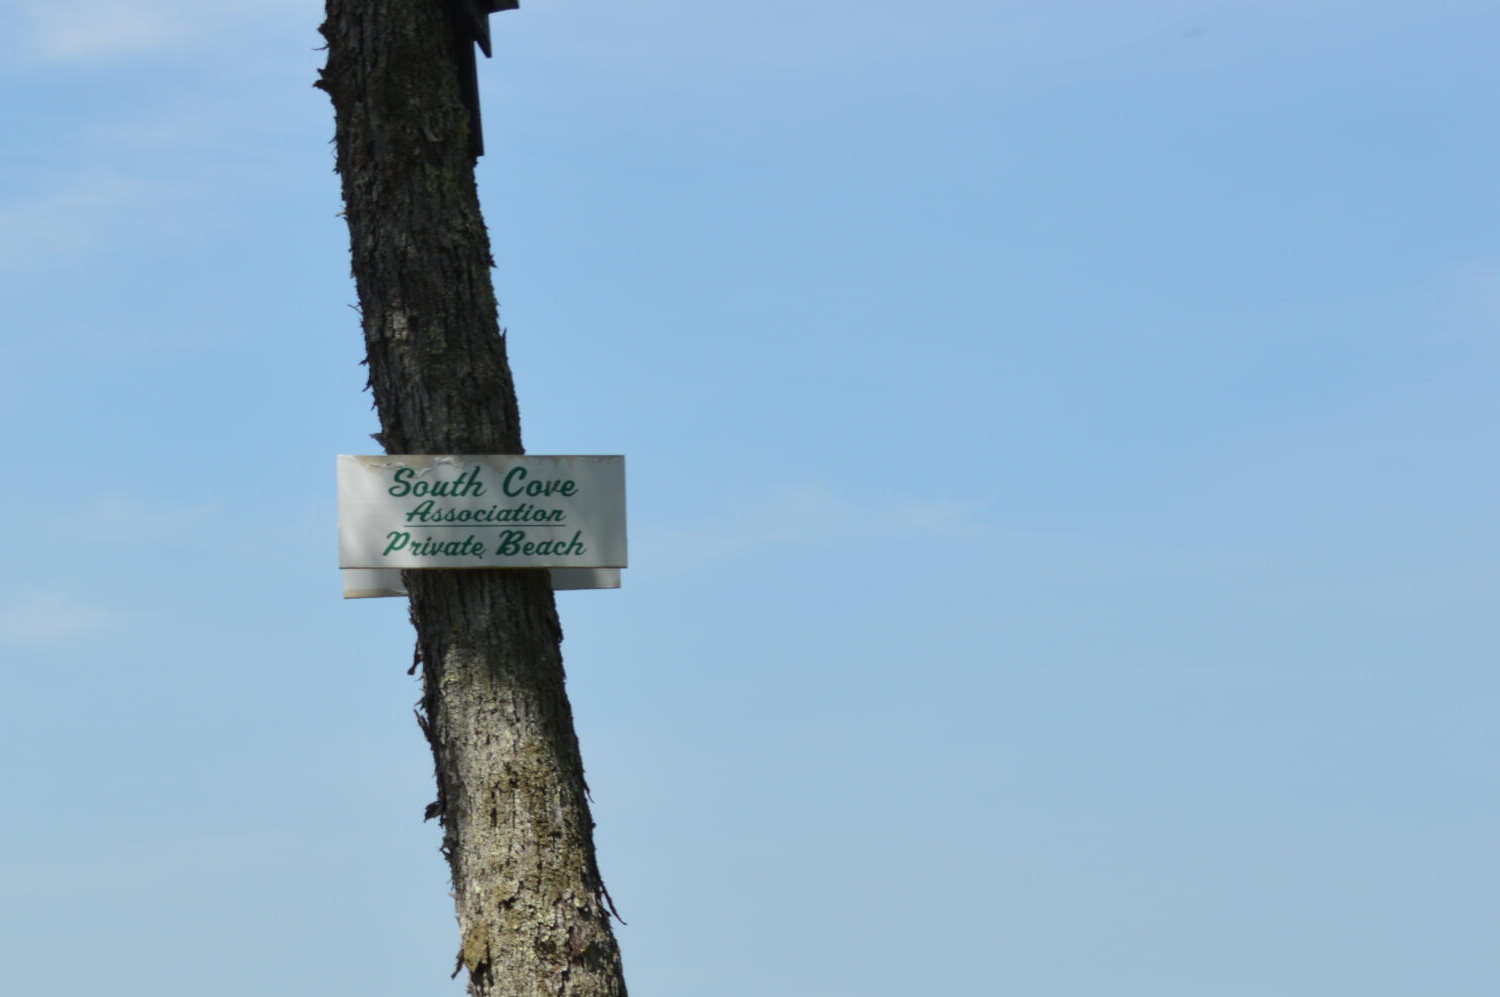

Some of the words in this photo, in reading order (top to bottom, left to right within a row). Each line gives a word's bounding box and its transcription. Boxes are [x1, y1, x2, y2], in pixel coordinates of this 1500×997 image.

[388, 465, 485, 497] South
[502, 466, 578, 497] Cove
[405, 499, 566, 523] Association
[382, 531, 485, 557] Private
[496, 530, 586, 556] Beach
